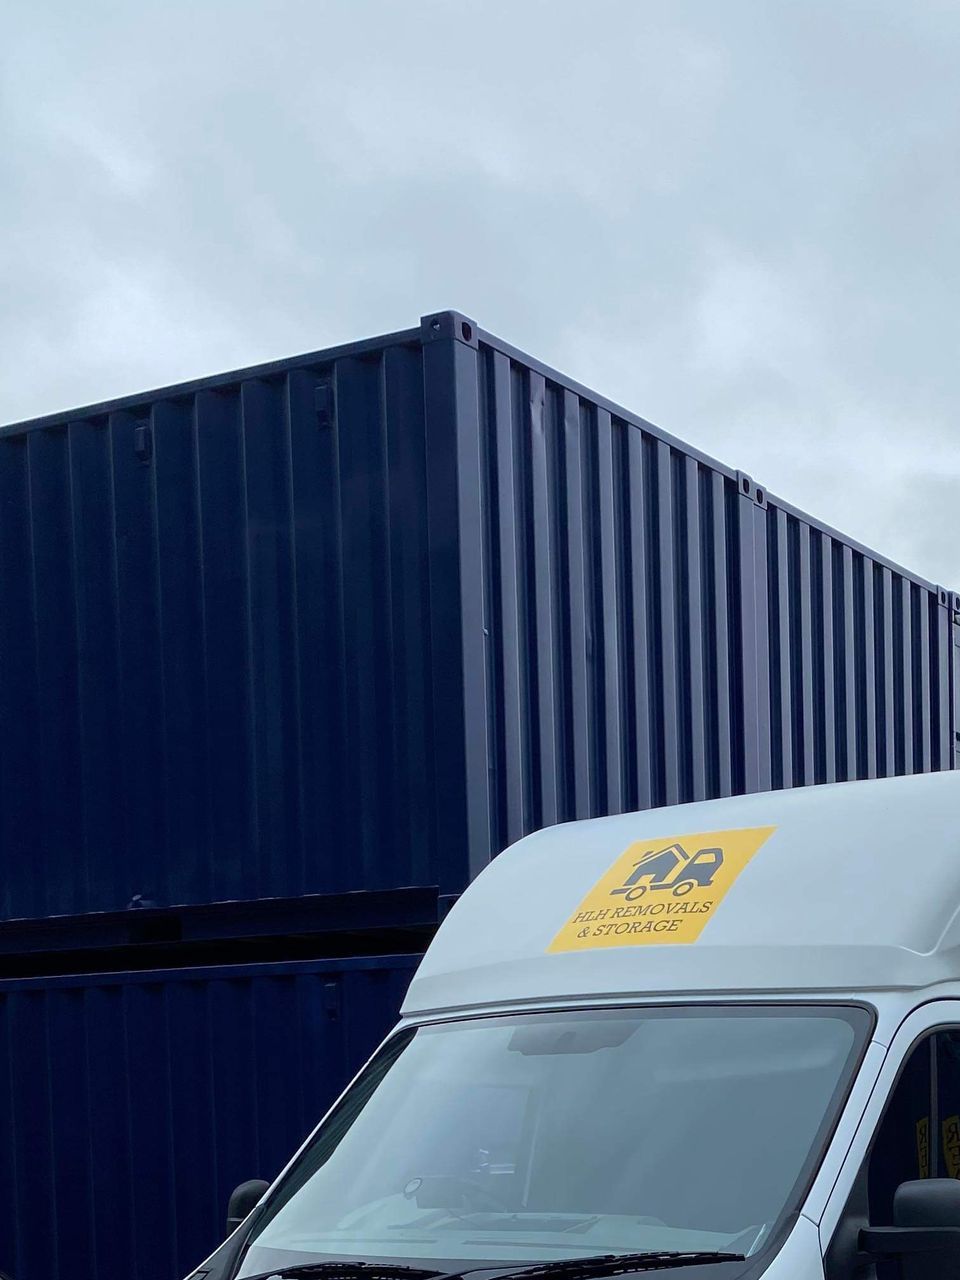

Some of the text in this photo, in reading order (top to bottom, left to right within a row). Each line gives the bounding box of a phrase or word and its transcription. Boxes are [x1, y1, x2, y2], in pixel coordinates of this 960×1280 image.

[573, 901, 713, 924] HLH REMOVALS
[577, 920, 682, 938] & STORAGE
